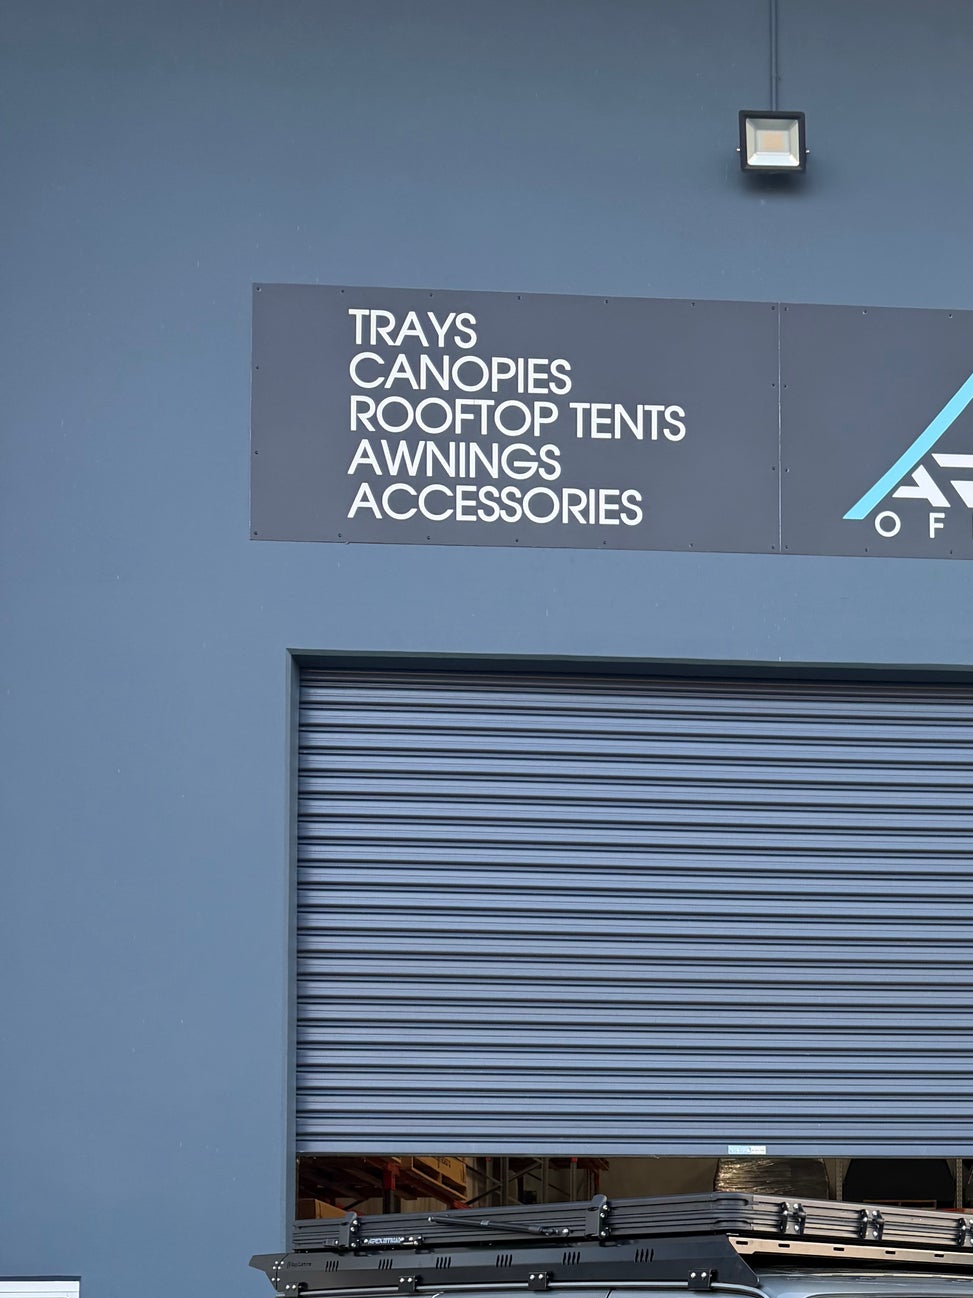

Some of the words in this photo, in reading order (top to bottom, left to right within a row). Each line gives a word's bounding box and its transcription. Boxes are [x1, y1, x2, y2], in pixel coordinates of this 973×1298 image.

[348, 308, 478, 349] TRAYS
[349, 352, 572, 396] CANOPIES
[350, 394, 559, 437] ROOFTOP
[569, 402, 687, 442] TENTS
[347, 439, 562, 481] AWNINGS
[347, 482, 643, 526] ACCESSORIES
